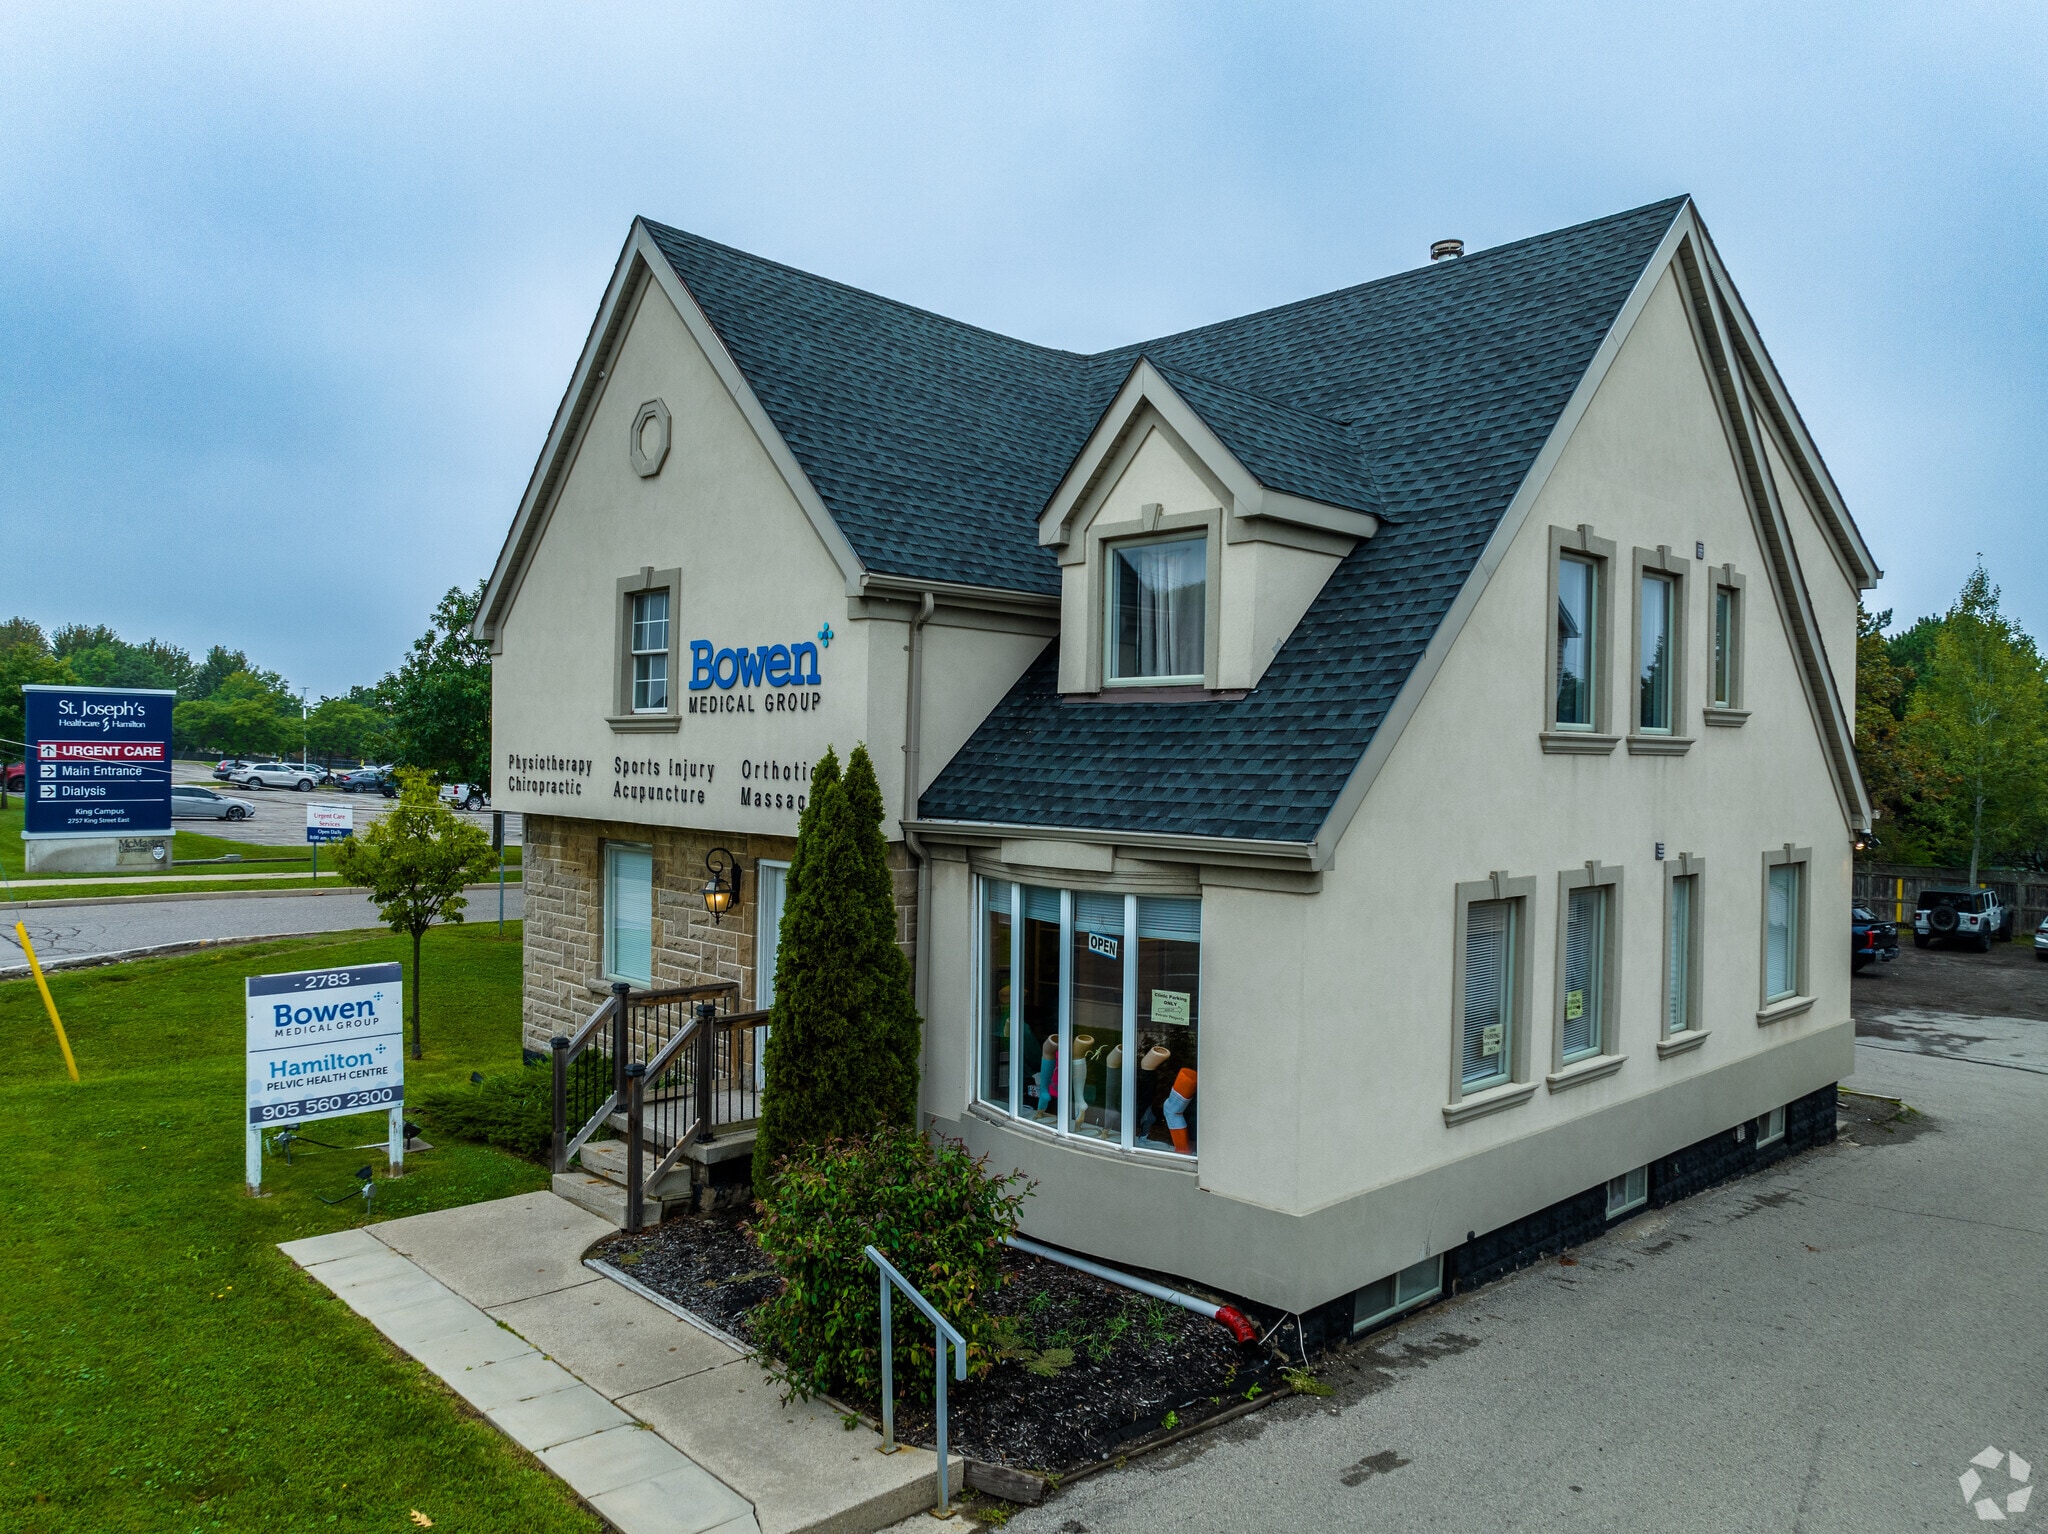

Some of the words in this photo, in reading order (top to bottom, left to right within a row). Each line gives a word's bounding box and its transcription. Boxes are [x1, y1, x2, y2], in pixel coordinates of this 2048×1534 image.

[688, 639, 822, 690] Bowen
[59, 699, 78, 715] St.
[80, 700, 146, 719] Joseph's
[689, 694, 755, 714] MEDICAL
[765, 692, 821, 712] GROUP
[58, 718, 100, 728] Healthcare
[112, 720, 146, 728] Hamilton
[62, 745, 121, 756] URGENT
[124, 746, 162, 757] CARE
[62, 765, 90, 776] Main
[94, 765, 143, 776] Entrance
[508, 754, 592, 776] Physiotherapy
[614, 756, 660, 778] Sports
[668, 758, 715, 783] Injury
[741, 759, 816, 781] Orthotic
[62, 785, 106, 798] Dialysis
[508, 776, 582, 796] Chiropractic
[613, 780, 705, 804] Acupuncture
[75, 808, 93, 816] King
[94, 807, 125, 815] Campus
[740, 786, 806, 815] Massag
[1090, 935, 1116, 955] OPEN
[305, 973, 350, 989] 2783
[273, 999, 375, 1028] Bowen
[274, 1024, 333, 1038] MEDICAL
[336, 1017, 379, 1030] GROUP
[269, 1052, 373, 1079] Hamilton
[266, 1078, 304, 1092] PELVIC
[306, 1072, 346, 1086] HEALTH
[349, 1066, 388, 1080] CENTRE
[262, 1103, 300, 1121] 905
[305, 1096, 342, 1114] 560
[346, 1088, 393, 1108] 2300
